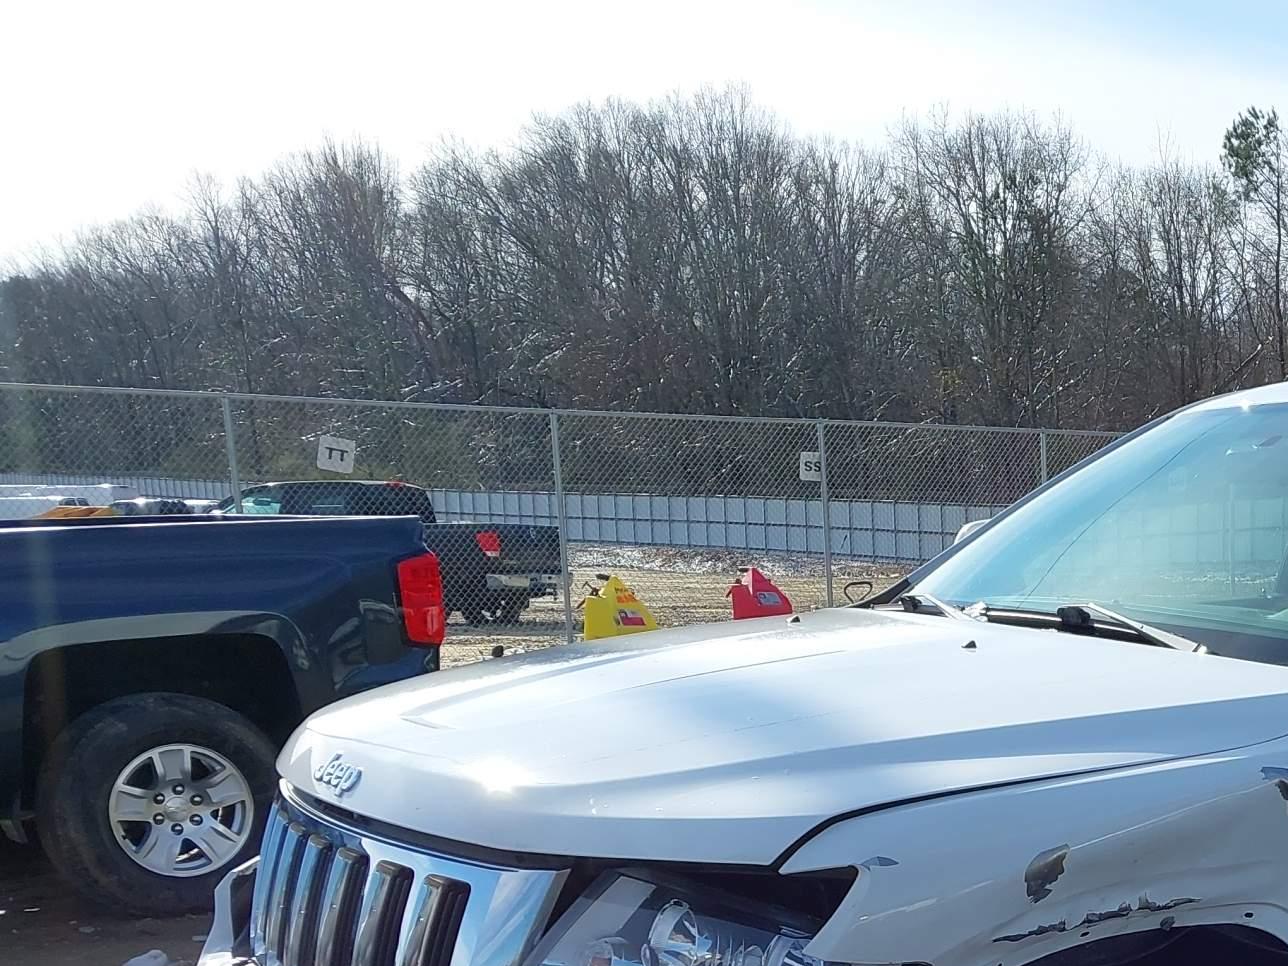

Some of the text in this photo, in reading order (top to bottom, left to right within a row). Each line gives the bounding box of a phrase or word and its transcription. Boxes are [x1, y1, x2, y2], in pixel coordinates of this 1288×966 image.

[324, 446, 349, 462] TT
[804, 460, 821, 472] SS
[313, 752, 363, 798] Jeep
